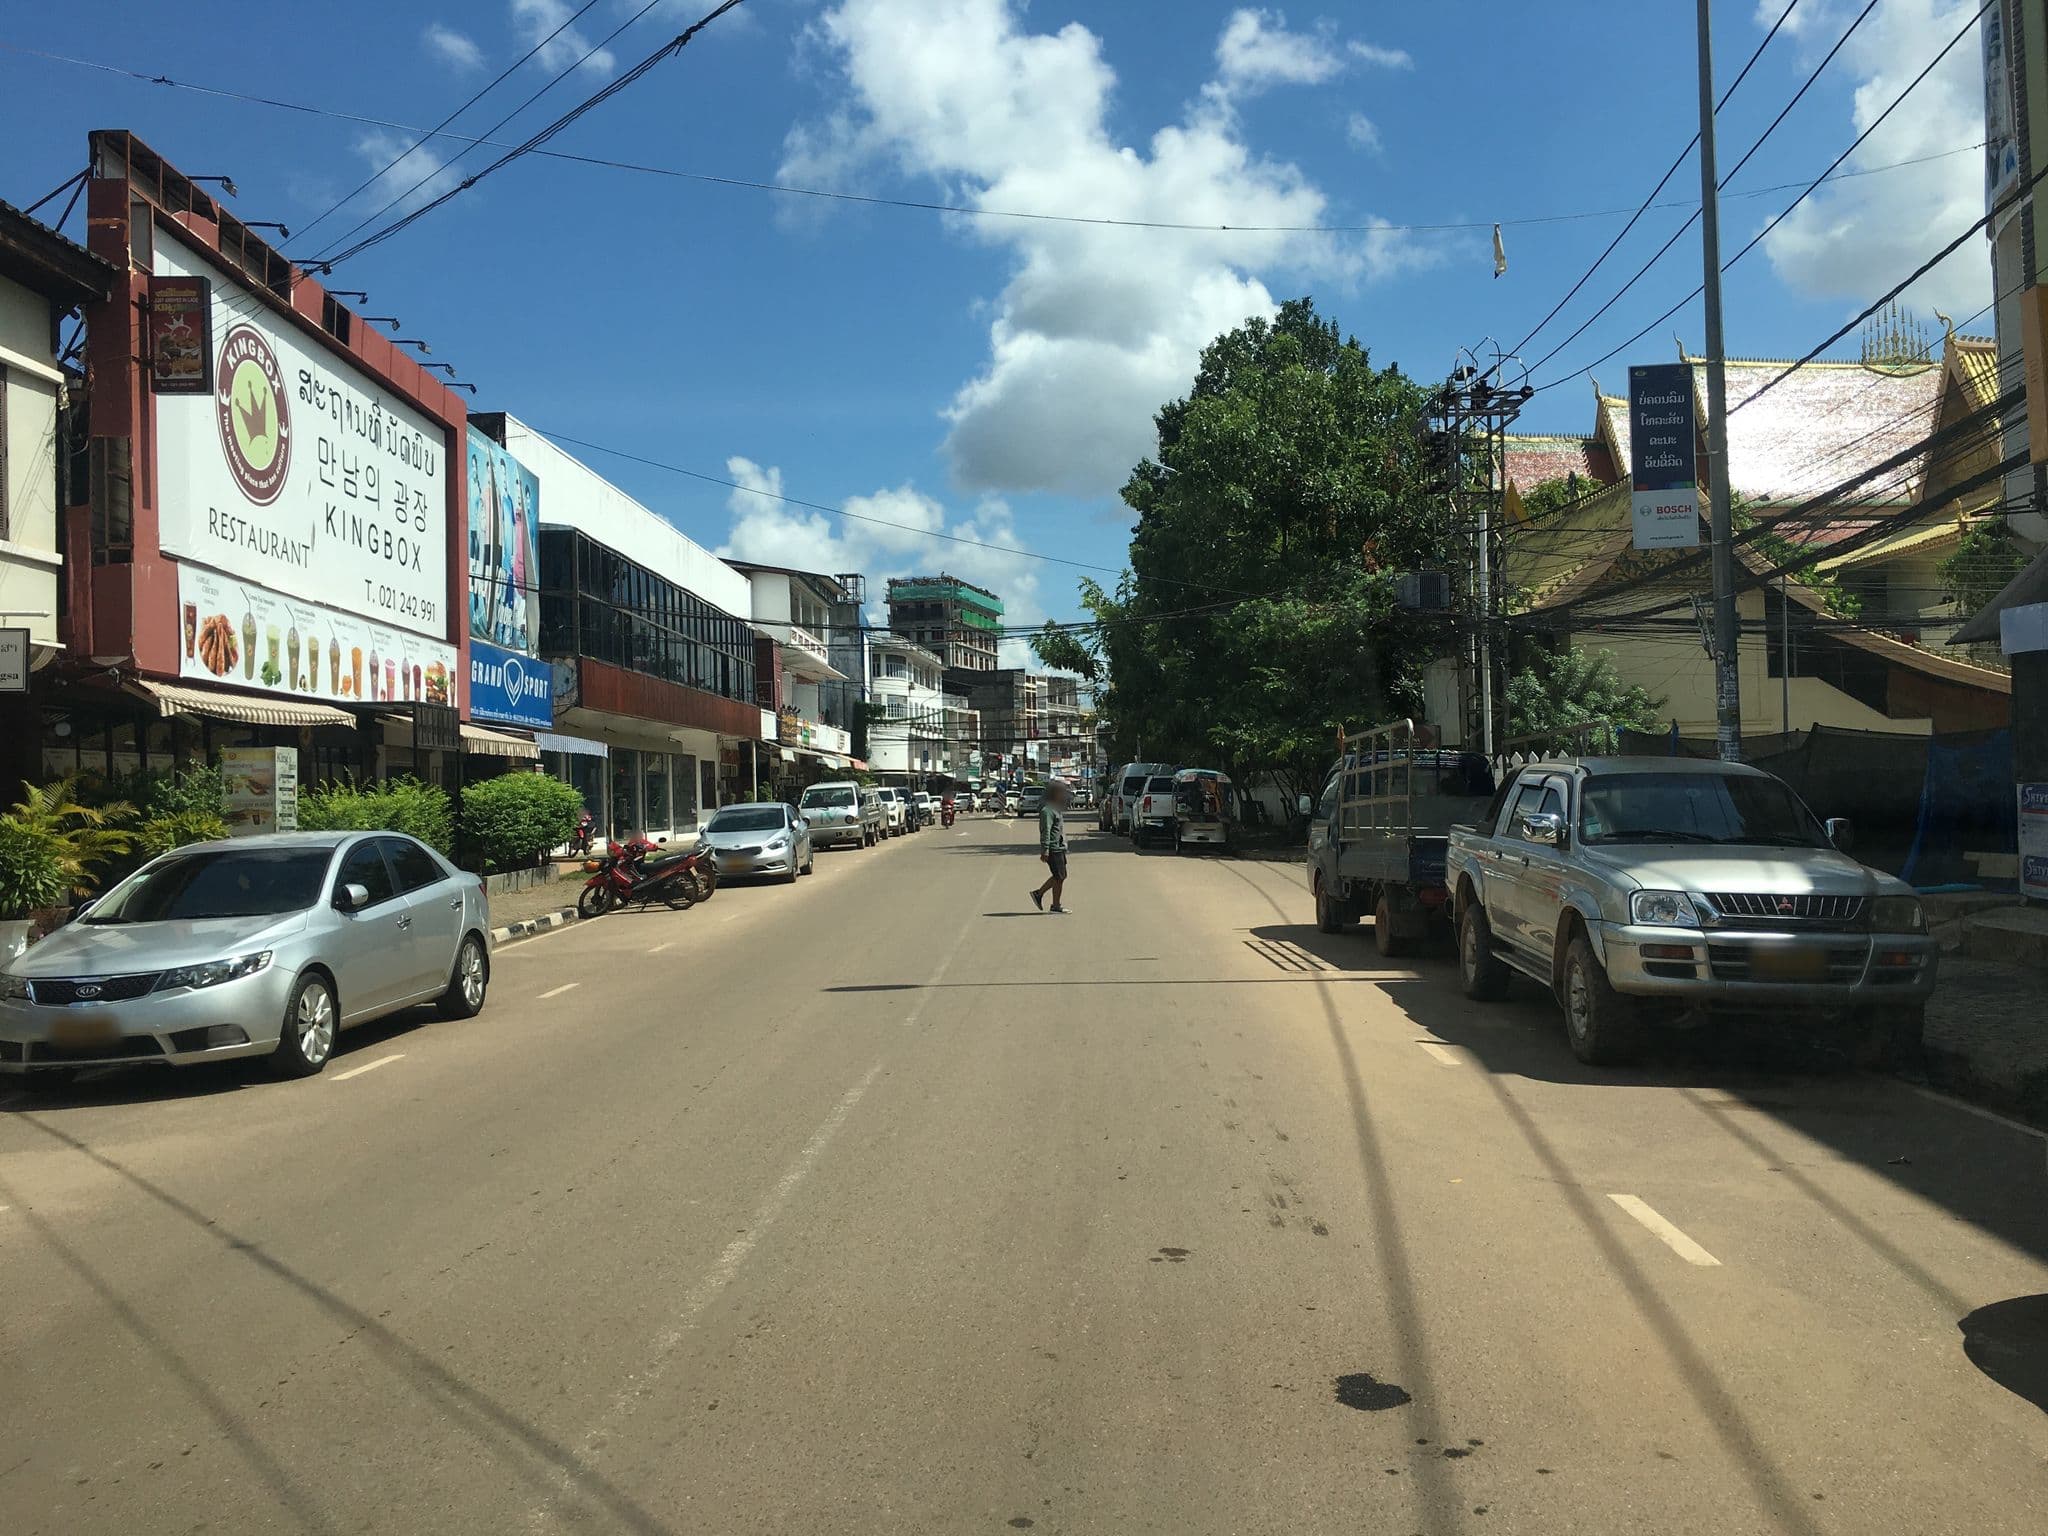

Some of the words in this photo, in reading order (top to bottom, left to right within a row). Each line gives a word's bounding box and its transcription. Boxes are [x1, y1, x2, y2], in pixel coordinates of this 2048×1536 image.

[226, 338, 281, 395] KINGBOX
[227, 435, 245, 475] meeting
[258, 479, 270, 489] that
[318, 436, 380, 512] 만남의
[394, 479, 428, 533] 광장
[1656, 505, 1692, 514] BOSCH
[209, 507, 310, 568] RESTAURANT
[325, 502, 422, 573] KINGBOX
[364, 579, 375, 602] T.
[379, 584, 396, 611] 021
[400, 592, 417, 618] 242
[421, 599, 436, 622] 991
[471, 660, 503, 687] GRAND
[524, 674, 549, 699] SPORT
